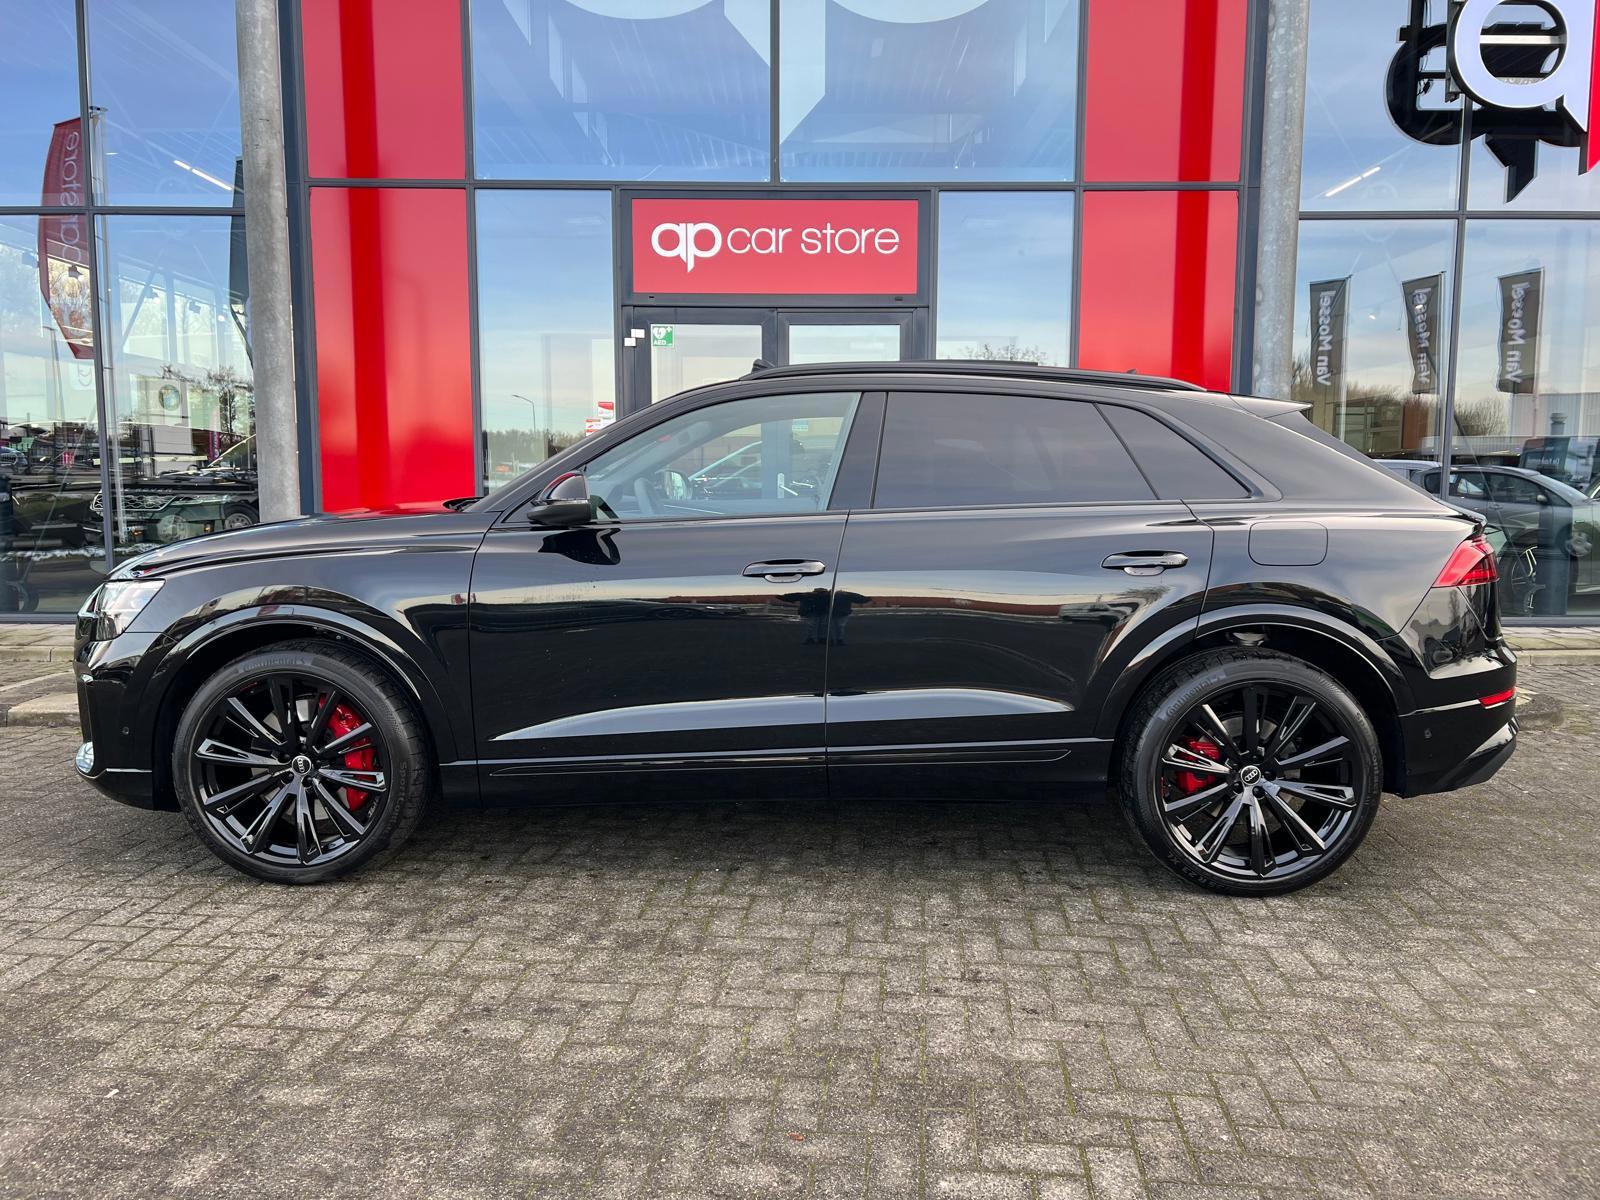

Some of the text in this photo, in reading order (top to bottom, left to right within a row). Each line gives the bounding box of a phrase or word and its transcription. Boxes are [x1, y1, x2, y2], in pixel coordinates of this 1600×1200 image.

[651, 222, 900, 272] ap car store
[1166, 678, 1213, 717] Continental
